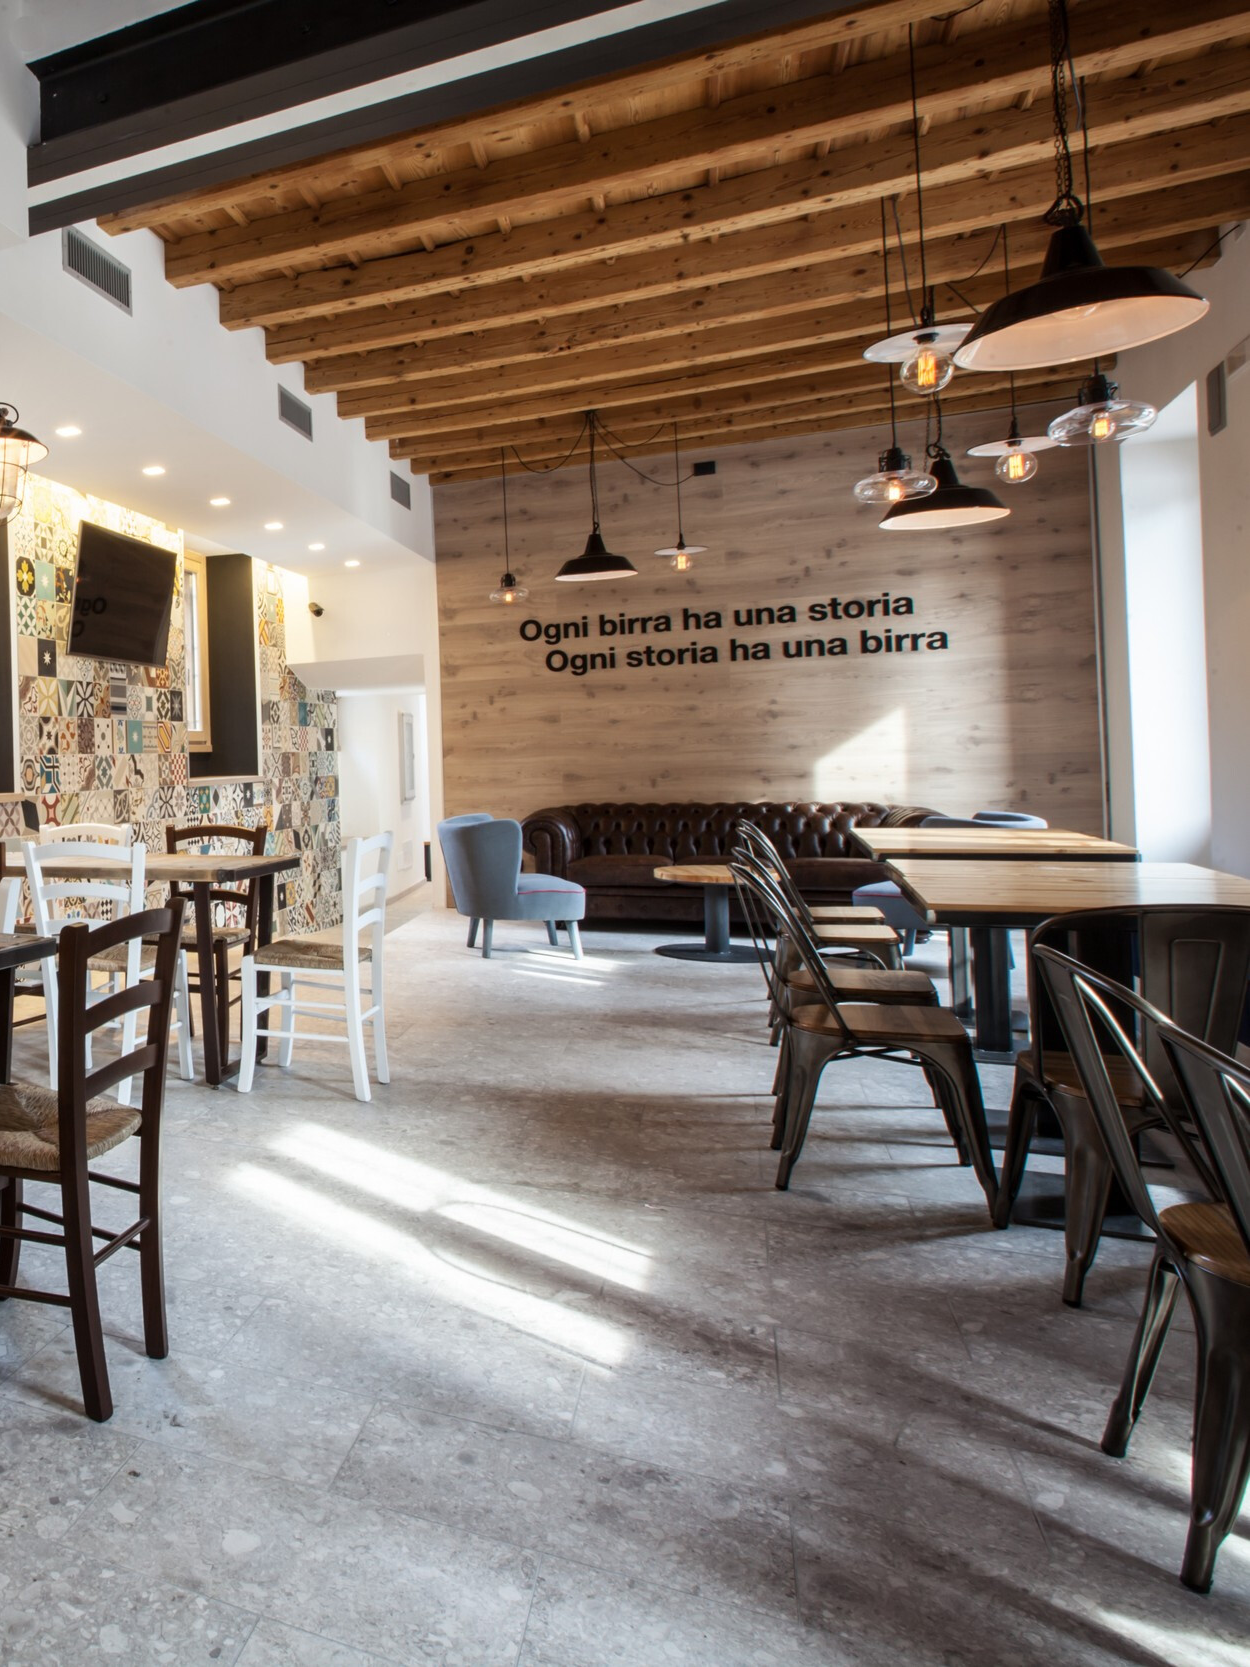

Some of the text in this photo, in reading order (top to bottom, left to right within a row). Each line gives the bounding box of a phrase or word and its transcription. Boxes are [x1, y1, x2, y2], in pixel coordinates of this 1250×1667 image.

[519, 592, 914, 645] Ogni birra ha una storia
[545, 628, 948, 676] Ogni storia ha una birra
